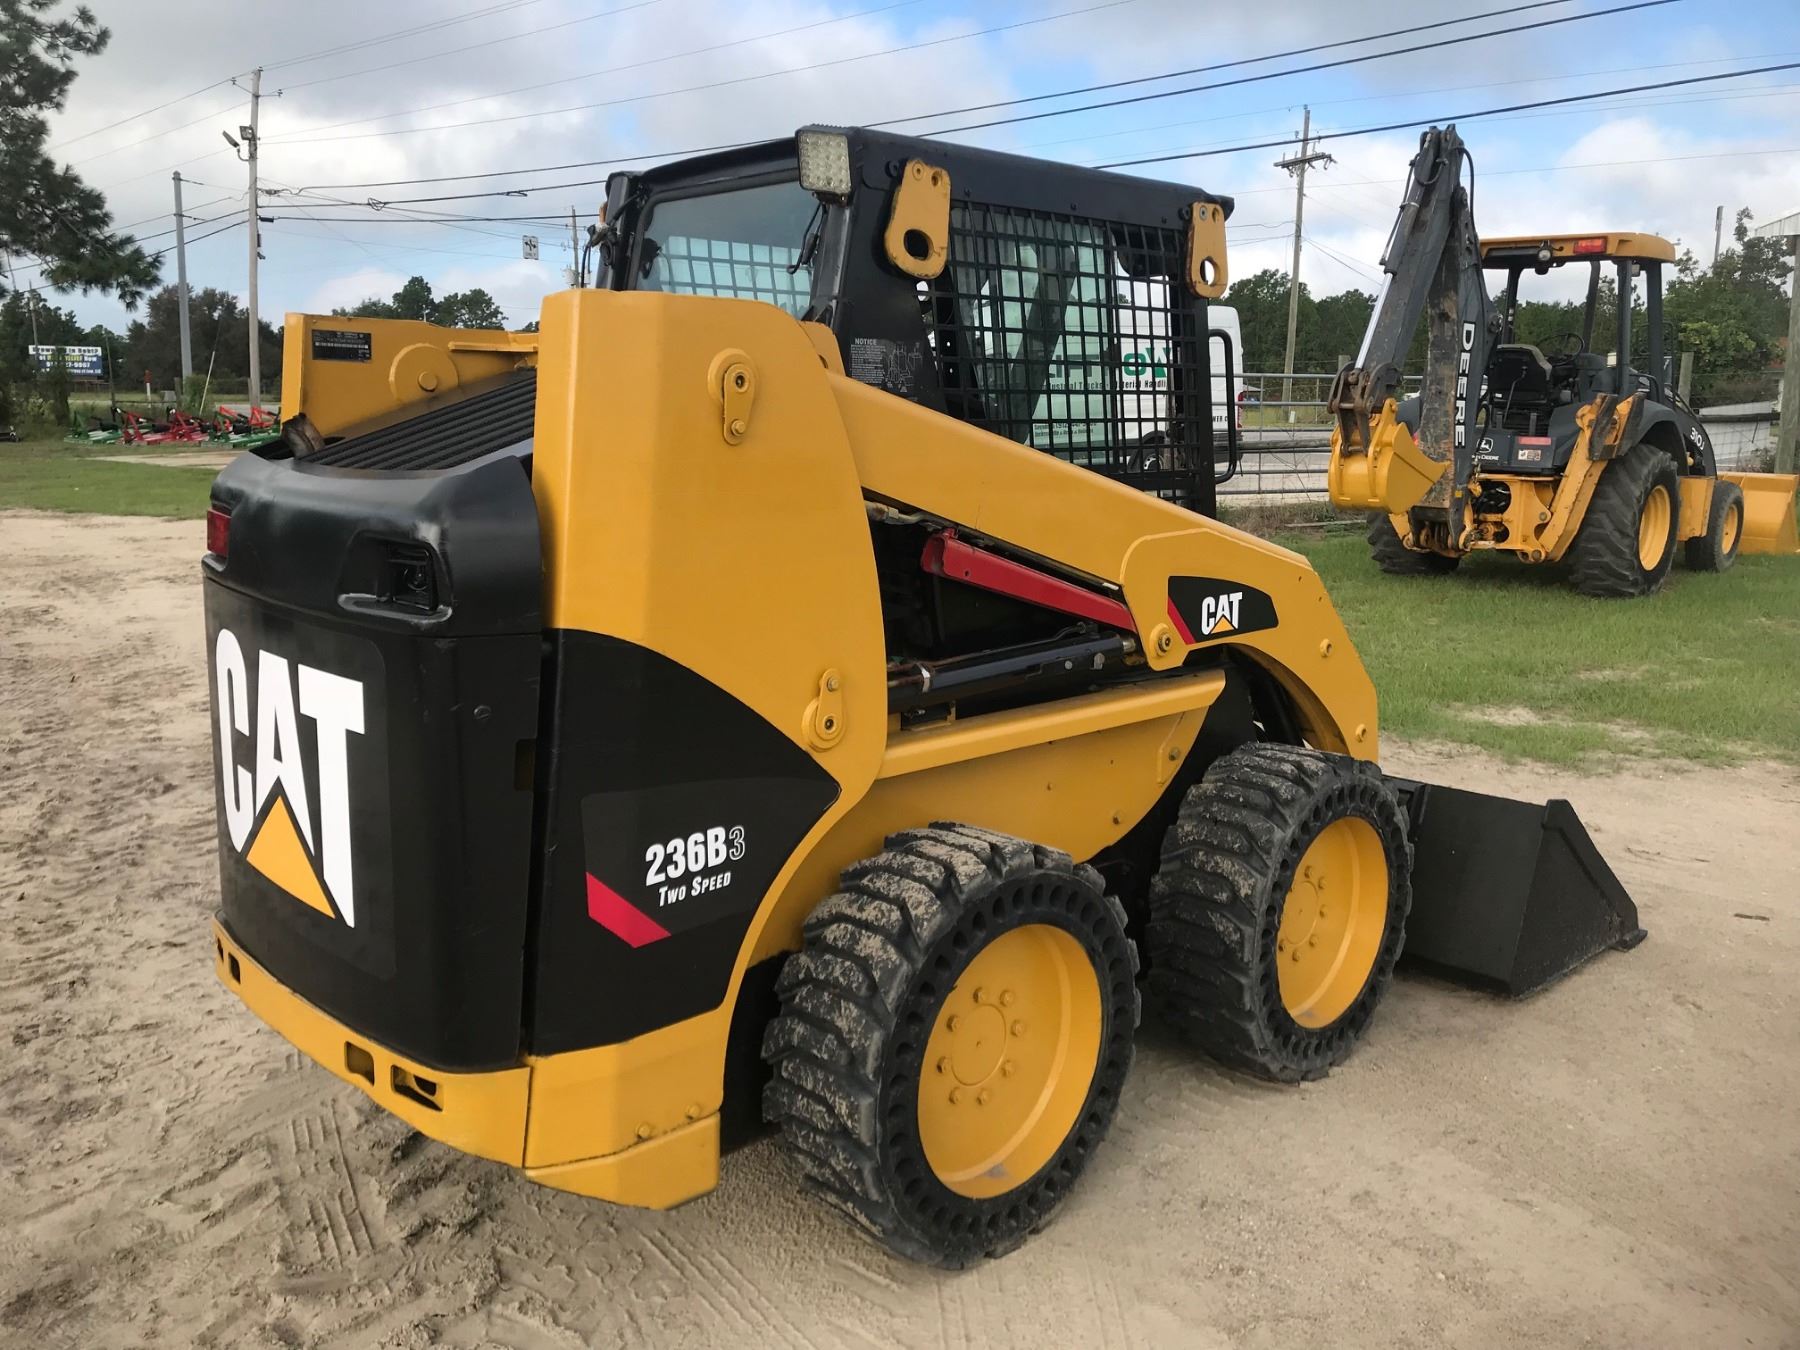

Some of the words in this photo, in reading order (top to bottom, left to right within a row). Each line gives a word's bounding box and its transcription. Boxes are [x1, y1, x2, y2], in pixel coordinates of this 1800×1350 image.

[1455, 323, 1475, 446] DEERE
[1690, 427, 1705, 450] 310J
[1201, 591, 1243, 635] CAT
[215, 628, 366, 929] CAT
[690, 871, 732, 897] SPEED
